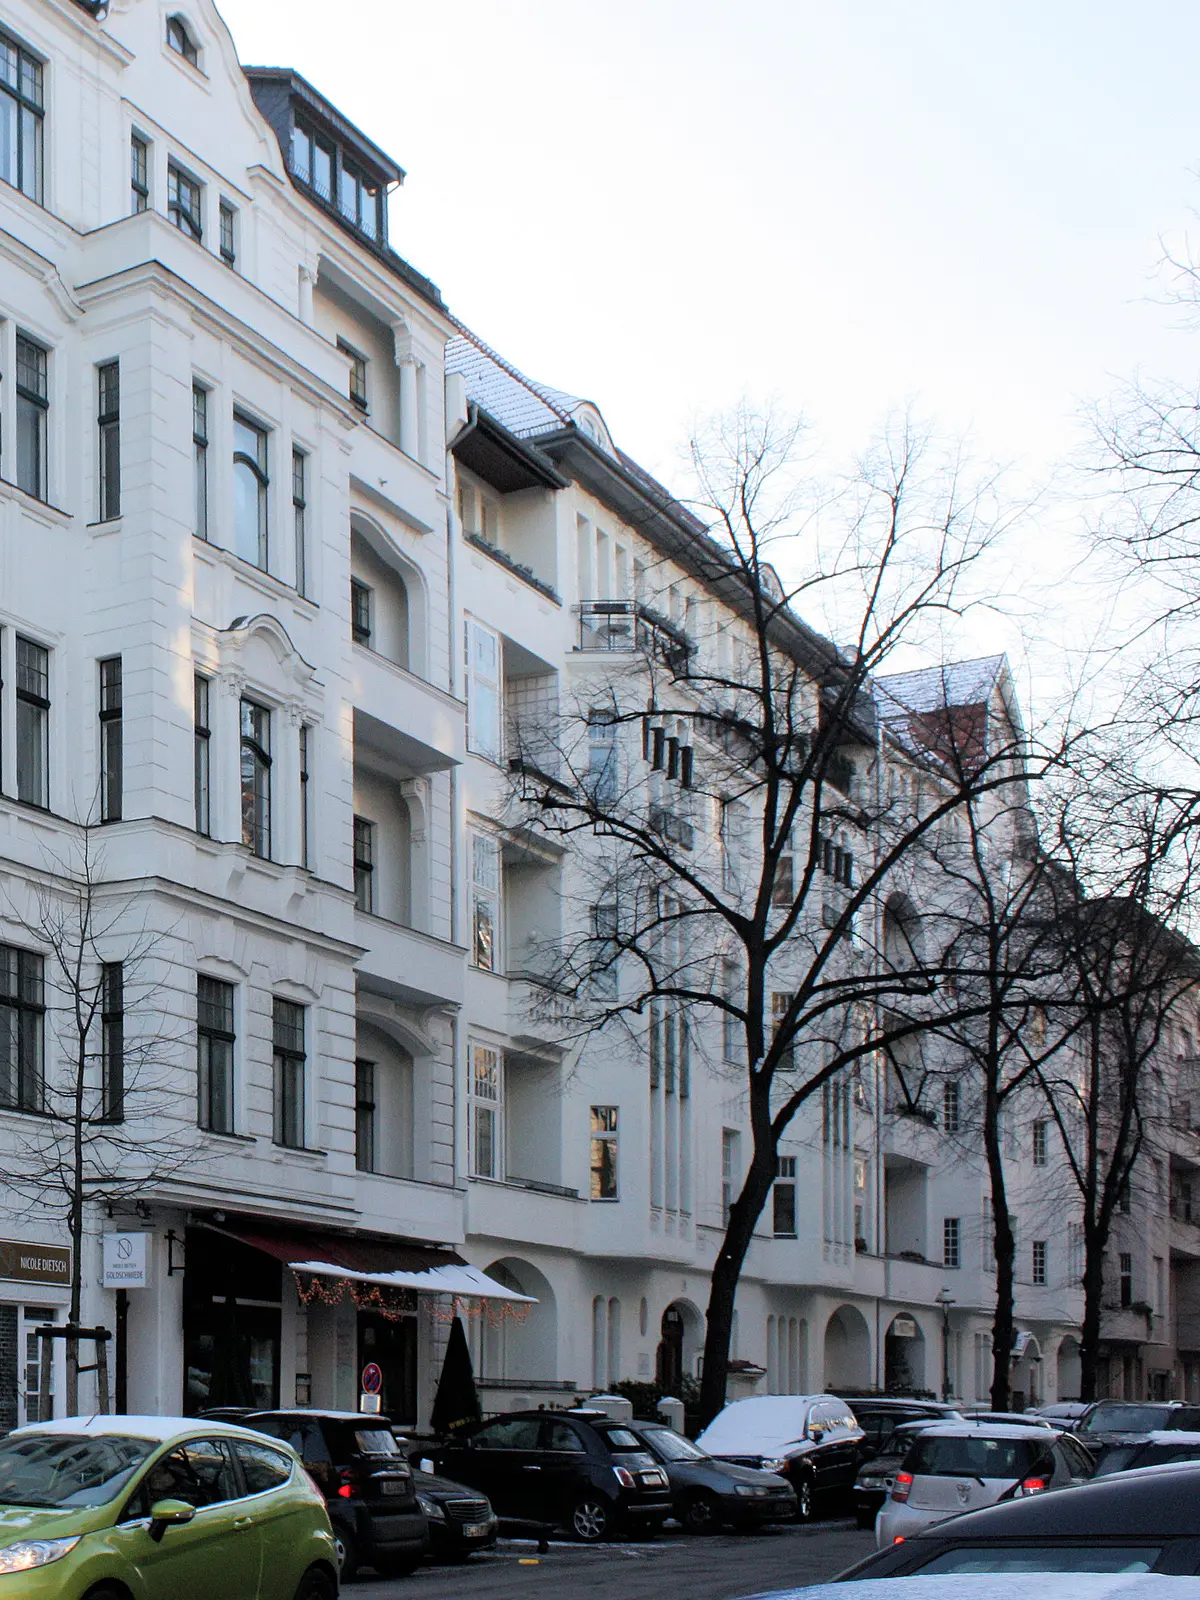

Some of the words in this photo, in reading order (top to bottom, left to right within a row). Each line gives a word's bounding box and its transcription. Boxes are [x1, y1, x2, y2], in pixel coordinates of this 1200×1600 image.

[20, 1257, 41, 1271] NICOLE
[42, 1259, 67, 1273] DIETSCH
[106, 1271, 143, 1280] GOLDSCHMIEDE
